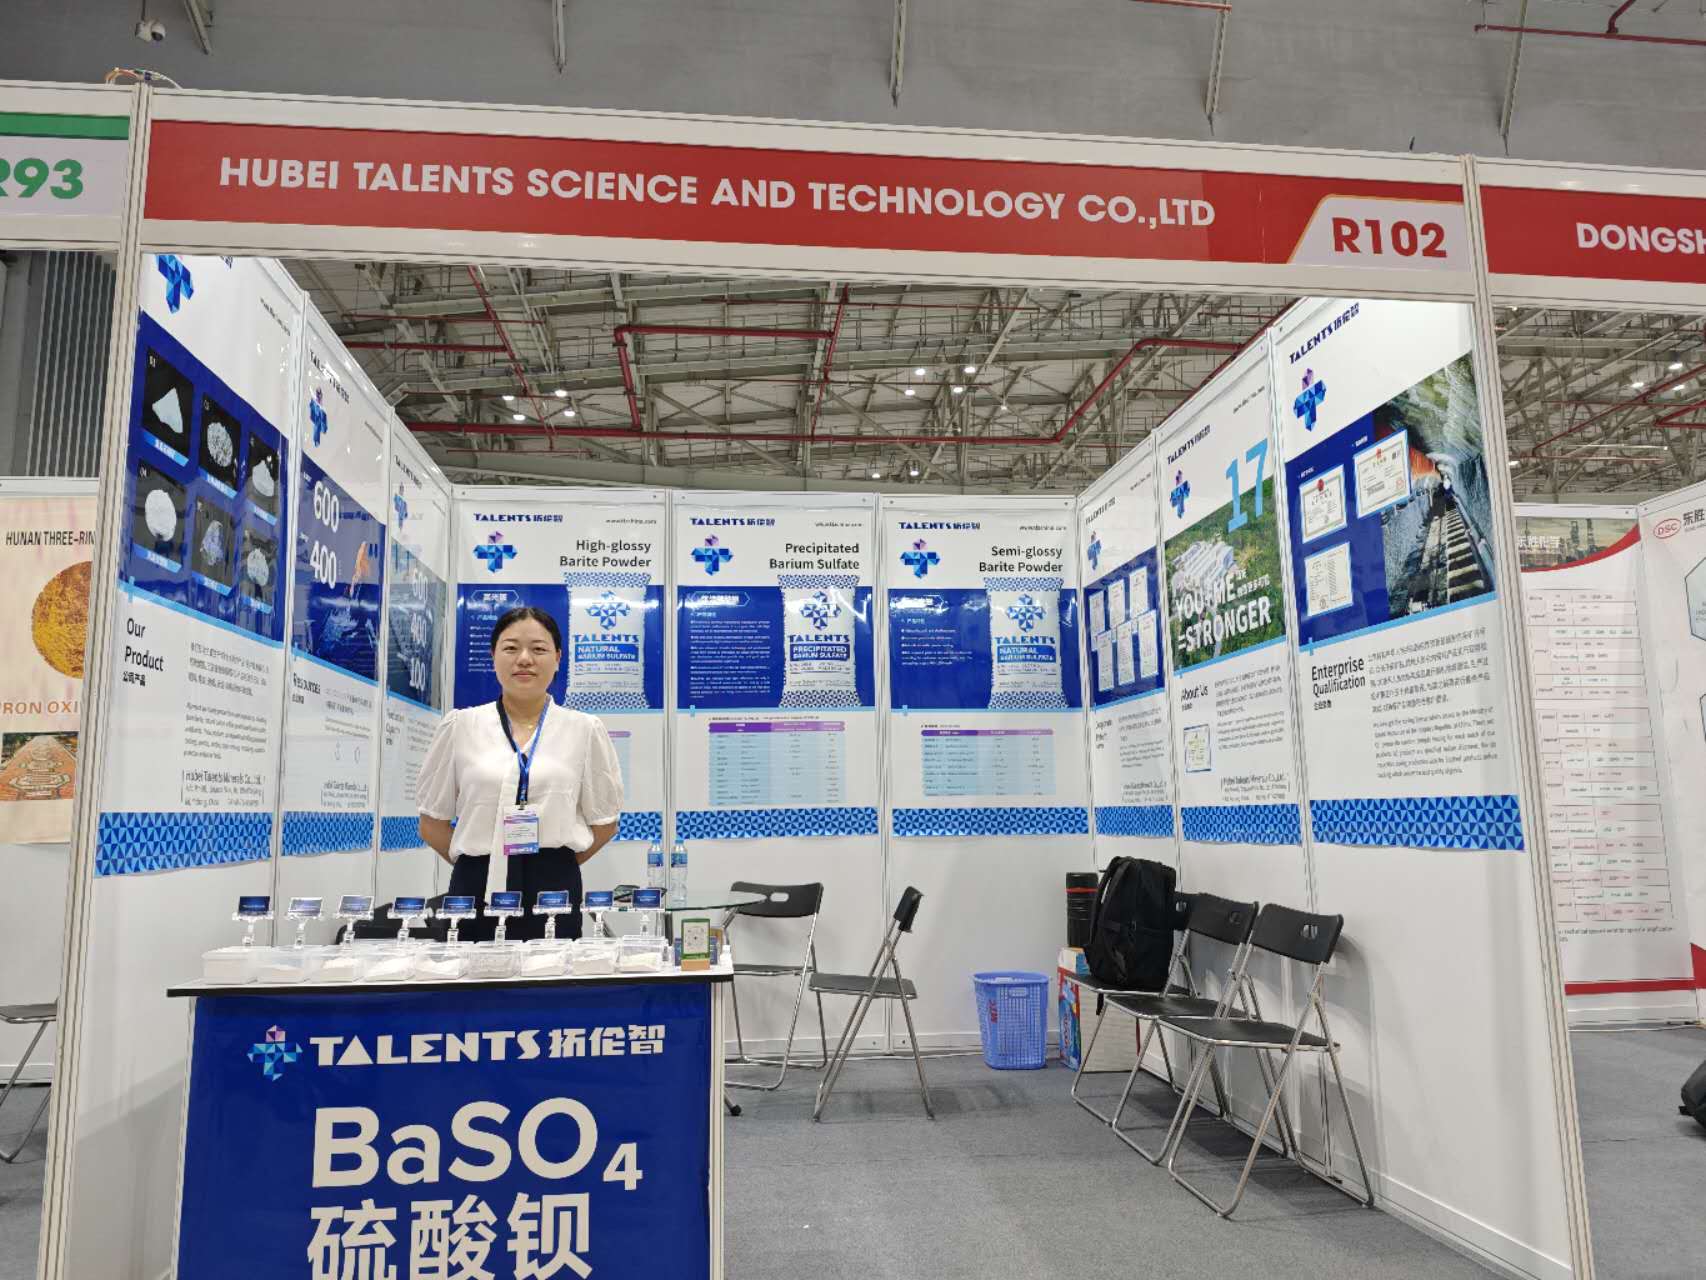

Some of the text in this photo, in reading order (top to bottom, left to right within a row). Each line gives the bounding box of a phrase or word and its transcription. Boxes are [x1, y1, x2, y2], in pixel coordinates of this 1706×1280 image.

[219, 157, 1215, 230] HUBEI TALENTS SCIENCE AND TECHNOLOGY CO.,LTD
[1332, 217, 1448, 259] R102
[1289, 323, 1333, 364] TALENTS
[1226, 438, 1268, 532] 17
[313, 480, 340, 533] 600
[473, 512, 531, 523] TALENTS
[690, 517, 745, 526] TALENTS
[898, 521, 952, 530] TALENTS
[1657, 523, 1678, 536] DSC
[5, 530, 41, 546] HUNAN
[575, 539, 652, 554] High-glossy
[785, 542, 860, 555] Precipitated
[991, 545, 1063, 560] Semi-glossy
[309, 540, 337, 589] 400
[559, 555, 652, 567] Barite Powder
[768, 558, 860, 570] Barium Sulfate
[979, 560, 1064, 572] Barite Powder
[126, 617, 146, 639] Our
[574, 634, 640, 643] TALENTS
[788, 634, 850, 643] TALENTS
[994, 636, 1056, 645] TALENTS
[124, 645, 165, 673] Product
[409, 657, 426, 692] 100
[1311, 656, 1365, 681] Enterprise
[1312, 675, 1366, 698] Qualification
[0, 702, 42, 714] RON
[309, 1023, 666, 1067] TALENTS 拓伦智
[306, 1192, 593, 1280] 硫酸钡
